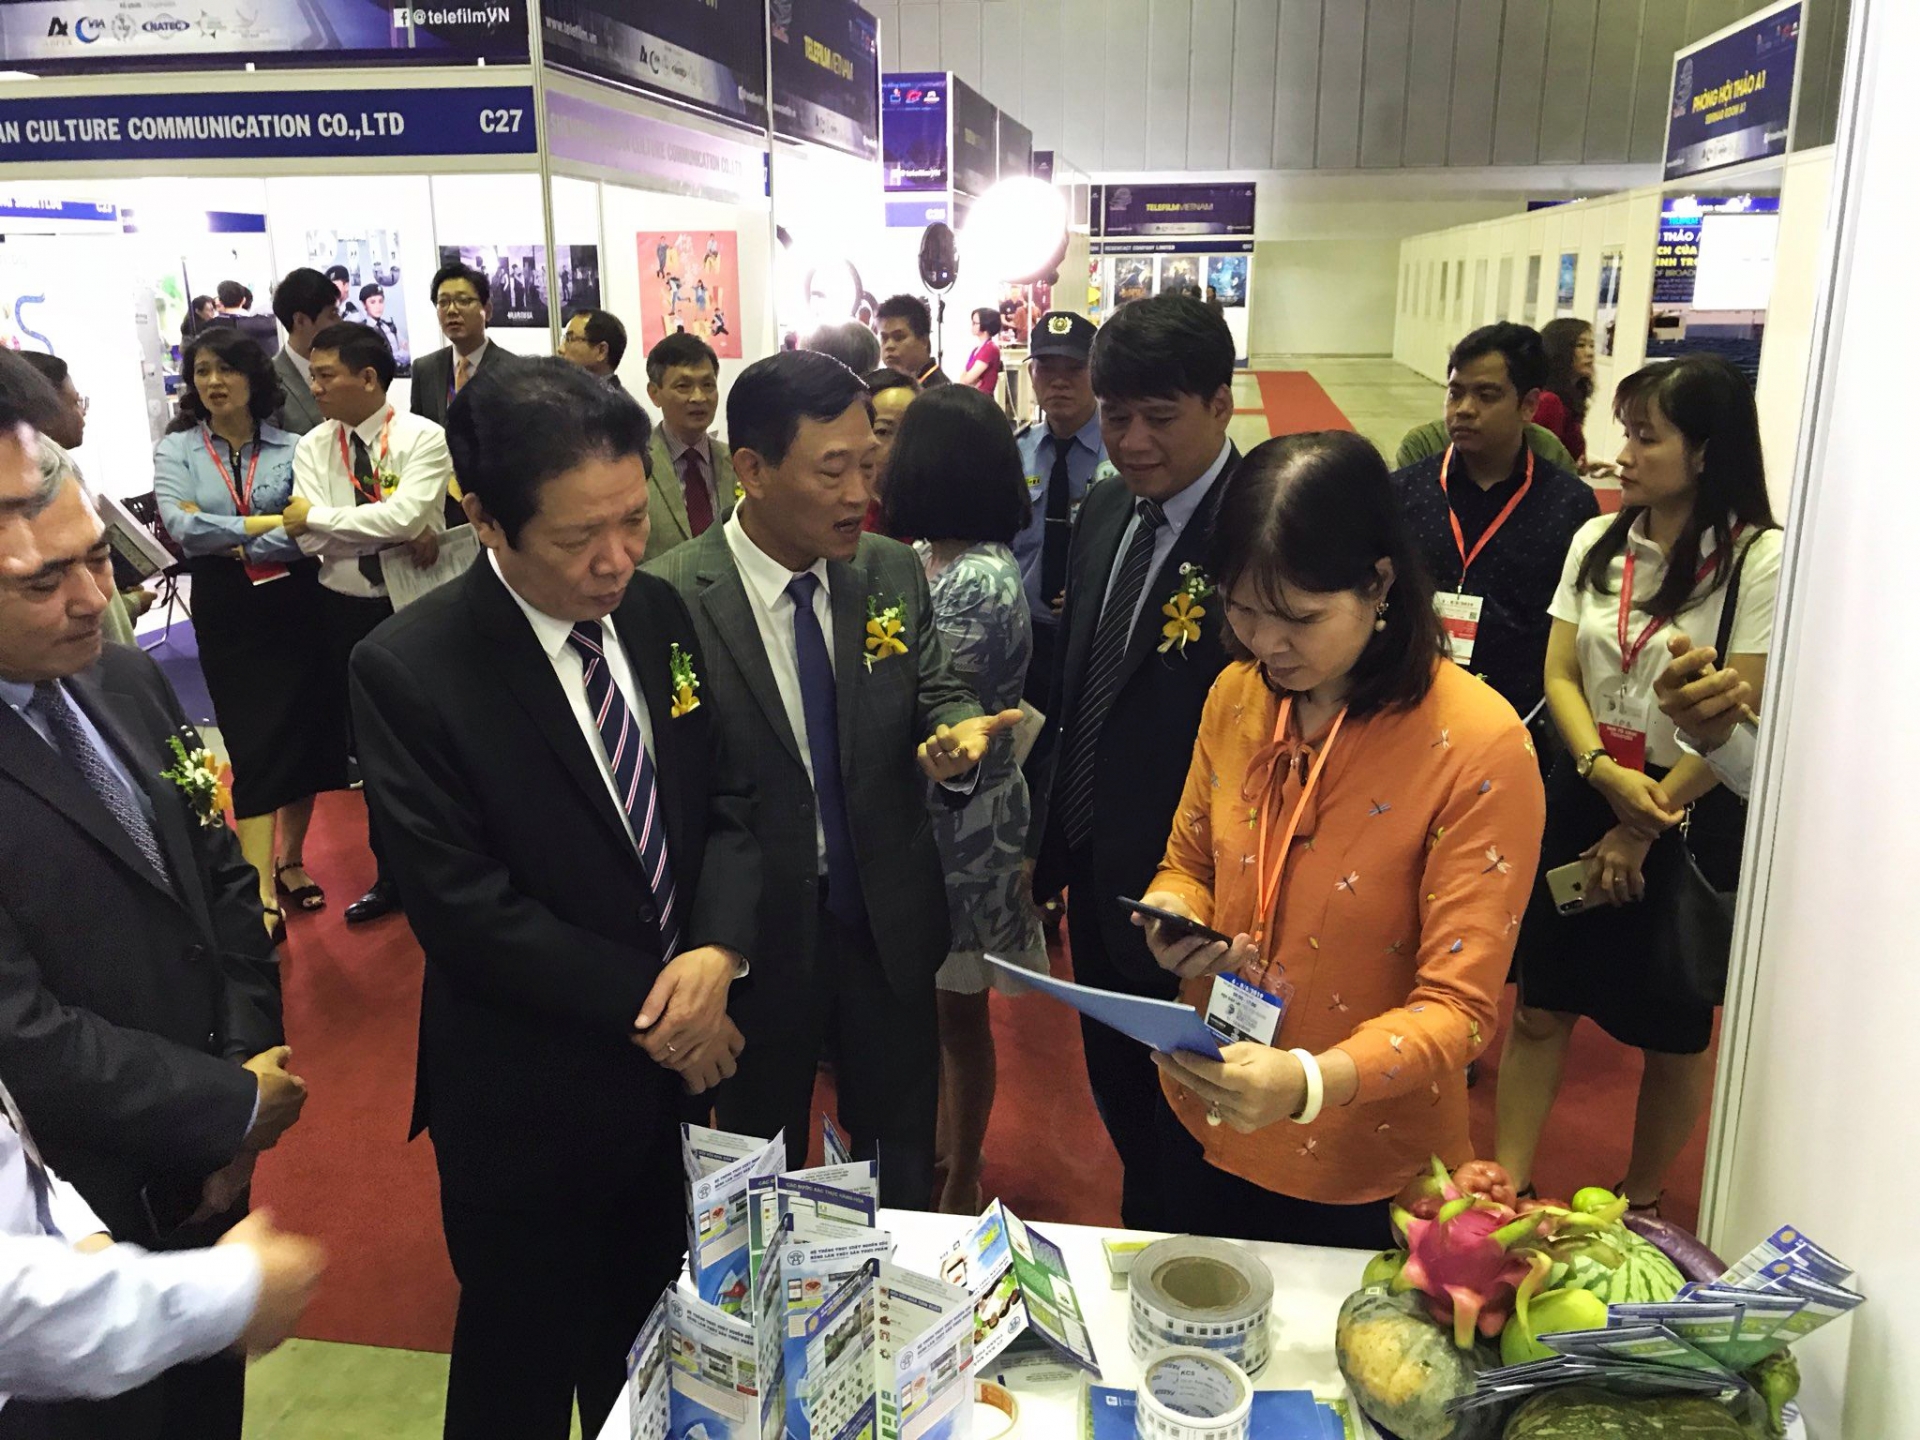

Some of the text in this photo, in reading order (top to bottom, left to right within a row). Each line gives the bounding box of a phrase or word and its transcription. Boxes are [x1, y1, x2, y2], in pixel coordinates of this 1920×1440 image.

[87, 18, 106, 29] VIA
[149, 20, 182, 31] NATEC
[26, 118, 121, 143] CULTURE
[128, 114, 310, 140] COMMUNICATION
[318, 112, 405, 140] CO.,LTD
[480, 109, 523, 133] C27
